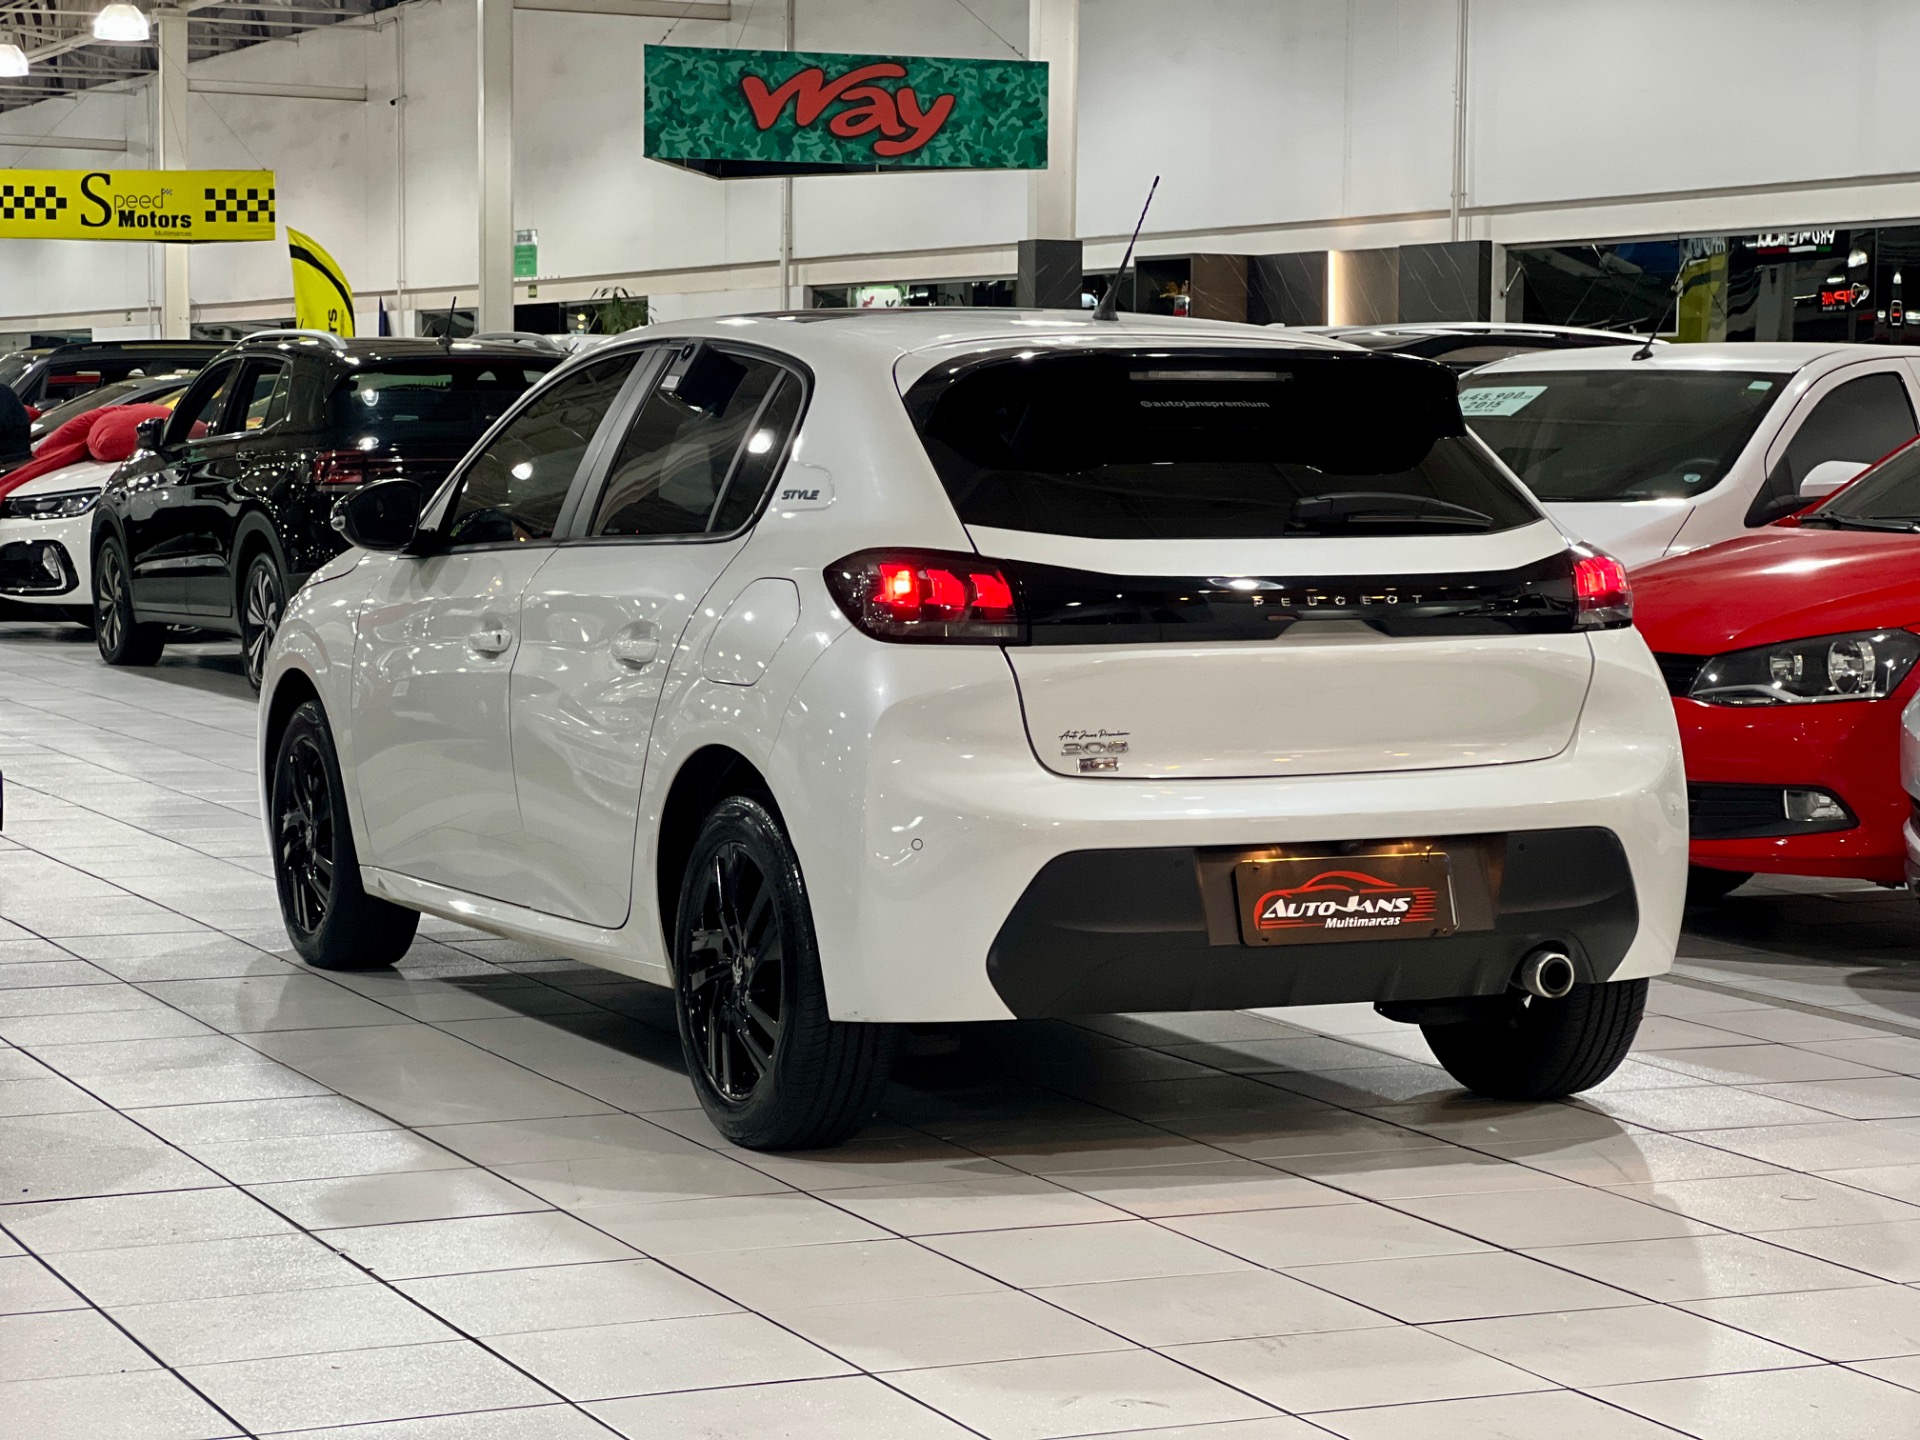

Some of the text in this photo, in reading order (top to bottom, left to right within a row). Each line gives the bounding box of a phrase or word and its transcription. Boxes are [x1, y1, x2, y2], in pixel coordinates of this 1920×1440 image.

[741, 63, 955, 156] Way
[80, 173, 163, 227] Speed
[118, 210, 192, 228] Motors
[1464, 400, 1504, 409] 2015
[781, 489, 820, 500] STYLE
[1252, 594, 1422, 607] PEUGEOT
[1324, 916, 1400, 929] Multimarcas
